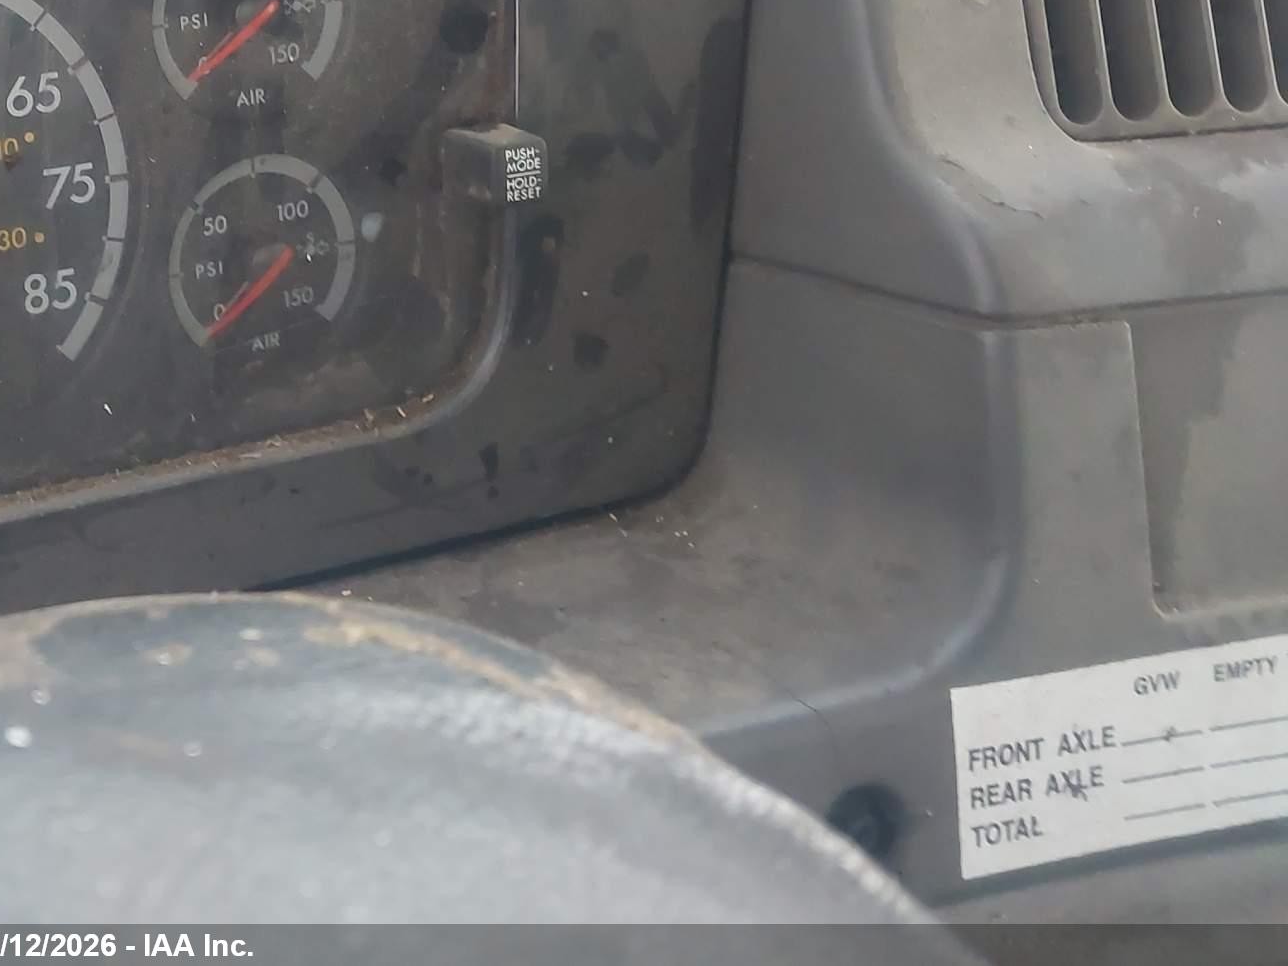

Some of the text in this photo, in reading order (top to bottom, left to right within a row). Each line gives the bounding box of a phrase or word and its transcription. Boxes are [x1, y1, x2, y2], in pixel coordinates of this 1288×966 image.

[180, 12, 208, 31] PSI
[269, 42, 299, 66] 150
[6, 72, 61, 117] 65
[236, 88, 266, 107] AIR
[506, 157, 542, 173] MODE
[42, 163, 95, 209] 75
[506, 187, 541, 202] RESET
[277, 200, 309, 221] 100
[203, 215, 228, 236] 50
[195, 260, 224, 279] PSI
[23, 268, 77, 315] 85
[283, 286, 313, 308] 150
[251, 333, 281, 352] AIR
[1133, 656, 1278, 695] GVW EMPTY
[968, 725, 1116, 772] FRONT AXLE
[970, 765, 1105, 810] REAR AXLE
[972, 815, 1044, 848] TOTAL
